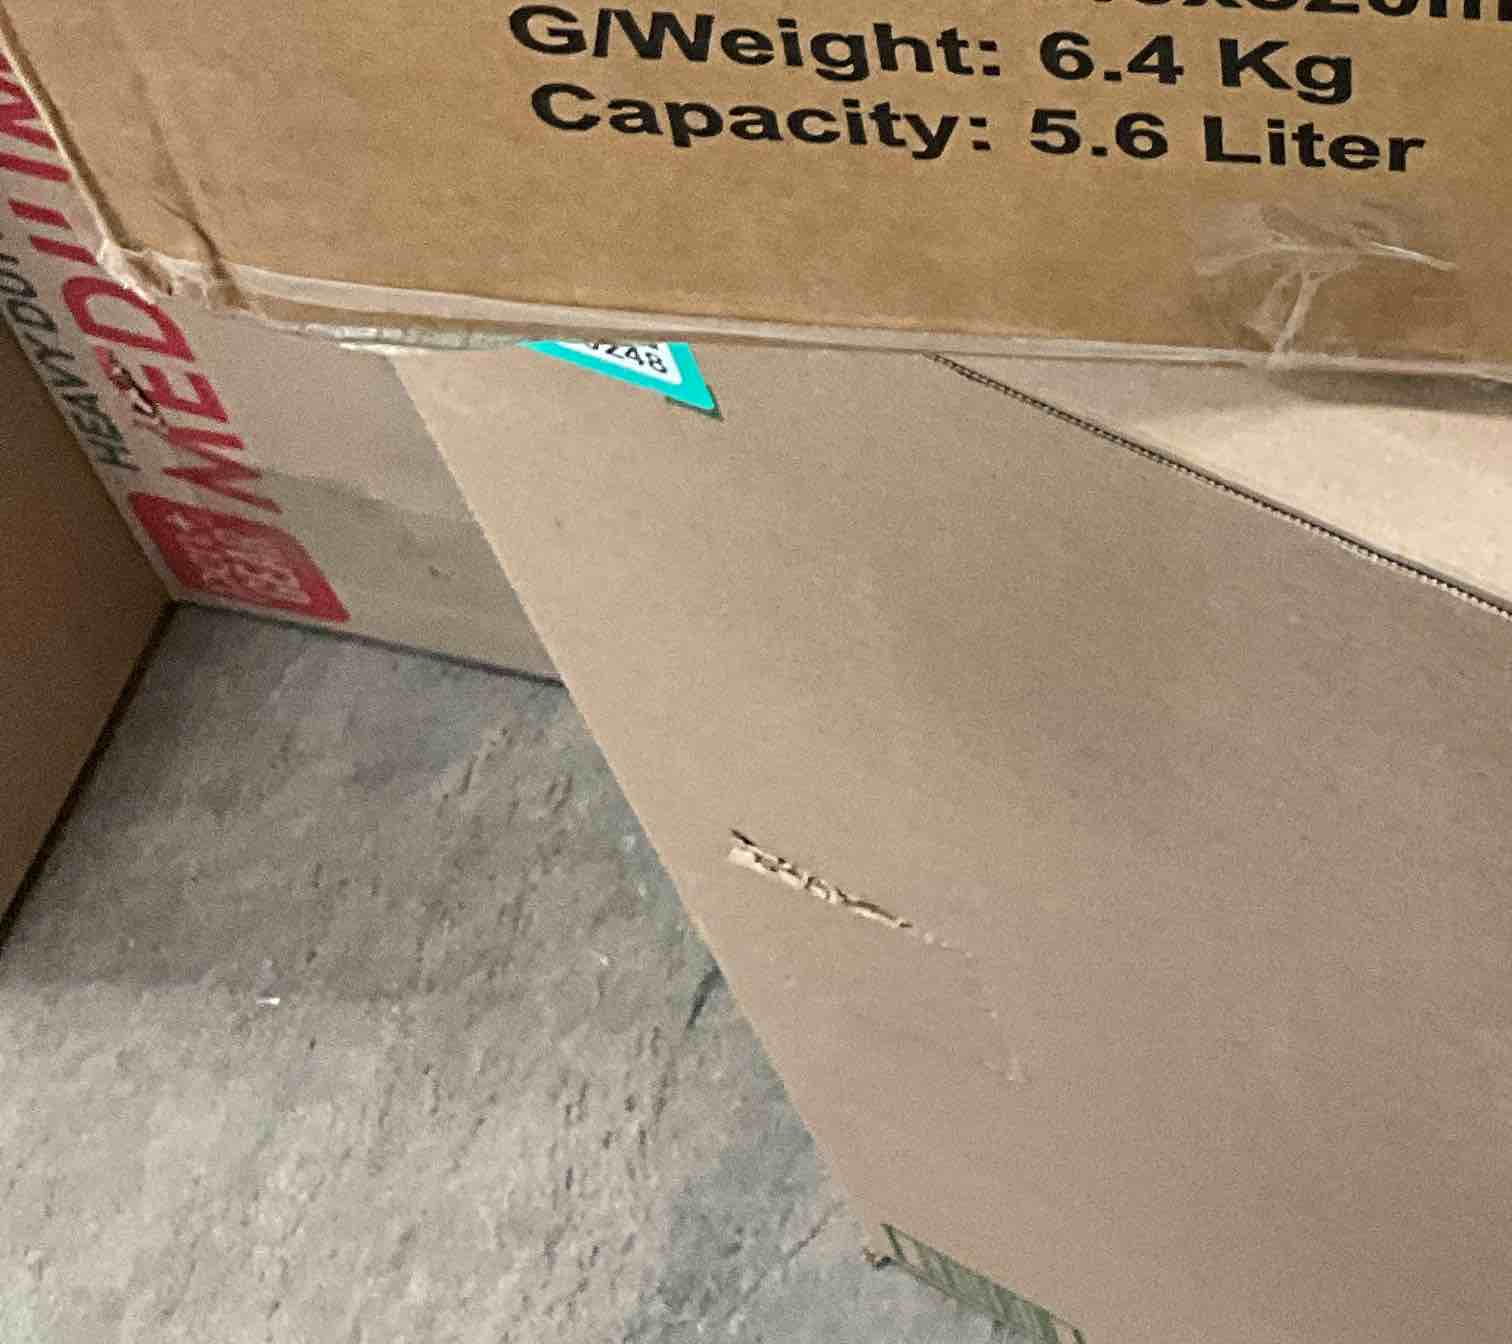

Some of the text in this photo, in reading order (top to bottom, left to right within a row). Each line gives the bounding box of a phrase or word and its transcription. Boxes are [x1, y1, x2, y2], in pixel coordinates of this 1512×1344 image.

[509, 5, 1352, 105] G/Weight: 6.4 Kg
[531, 83, 1426, 172] Capacity: 5.6 Liter
